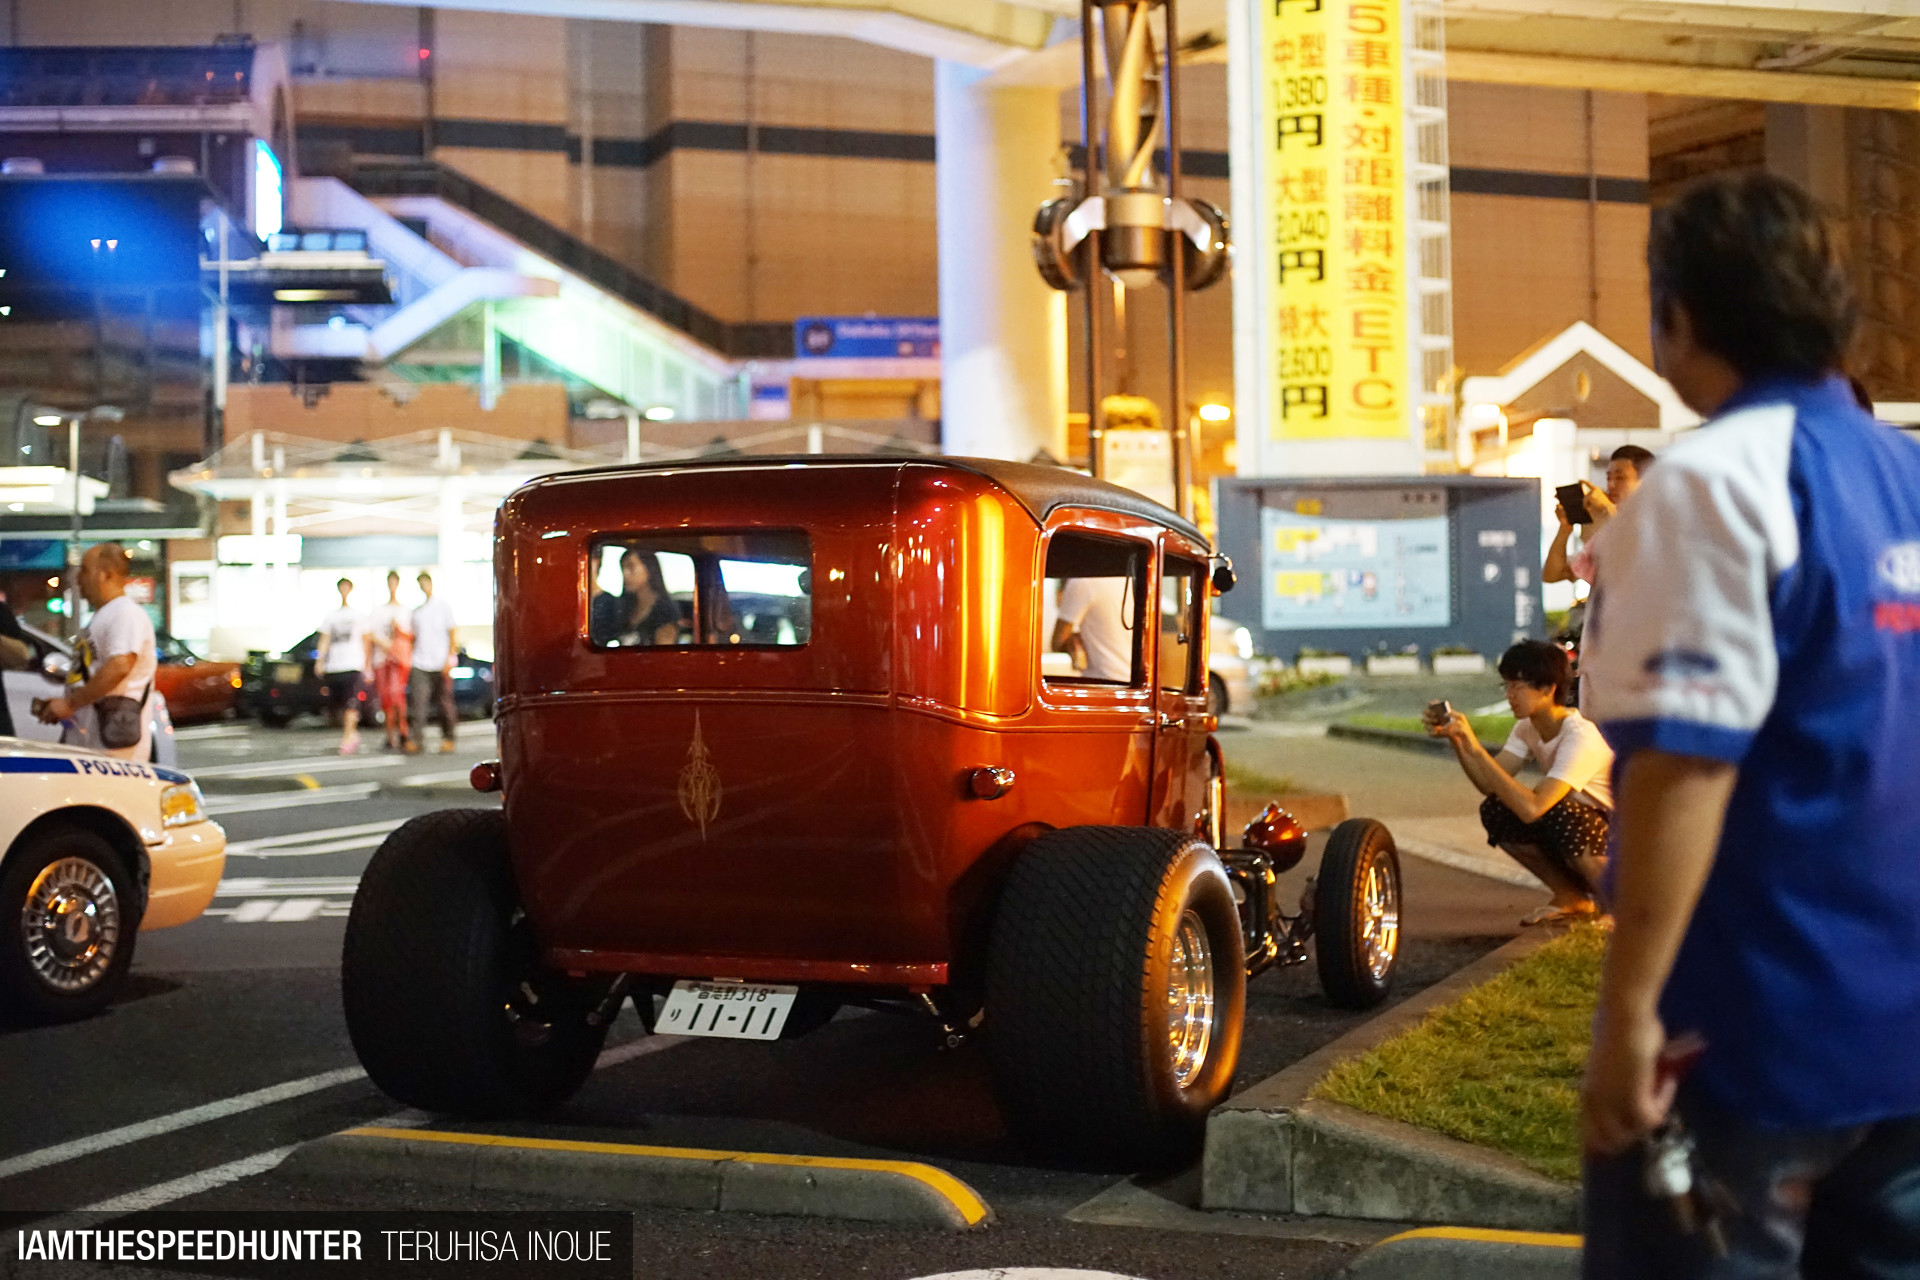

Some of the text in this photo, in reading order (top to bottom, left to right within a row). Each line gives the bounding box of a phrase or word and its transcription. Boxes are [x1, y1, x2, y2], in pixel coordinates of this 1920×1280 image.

[1277, 114, 1323, 151] 円
[1279, 249, 1324, 285] 円
[1282, 383, 1328, 420] 円
[77, 759, 152, 779] POLICE
[688, 1003, 777, 1034] 11-11
